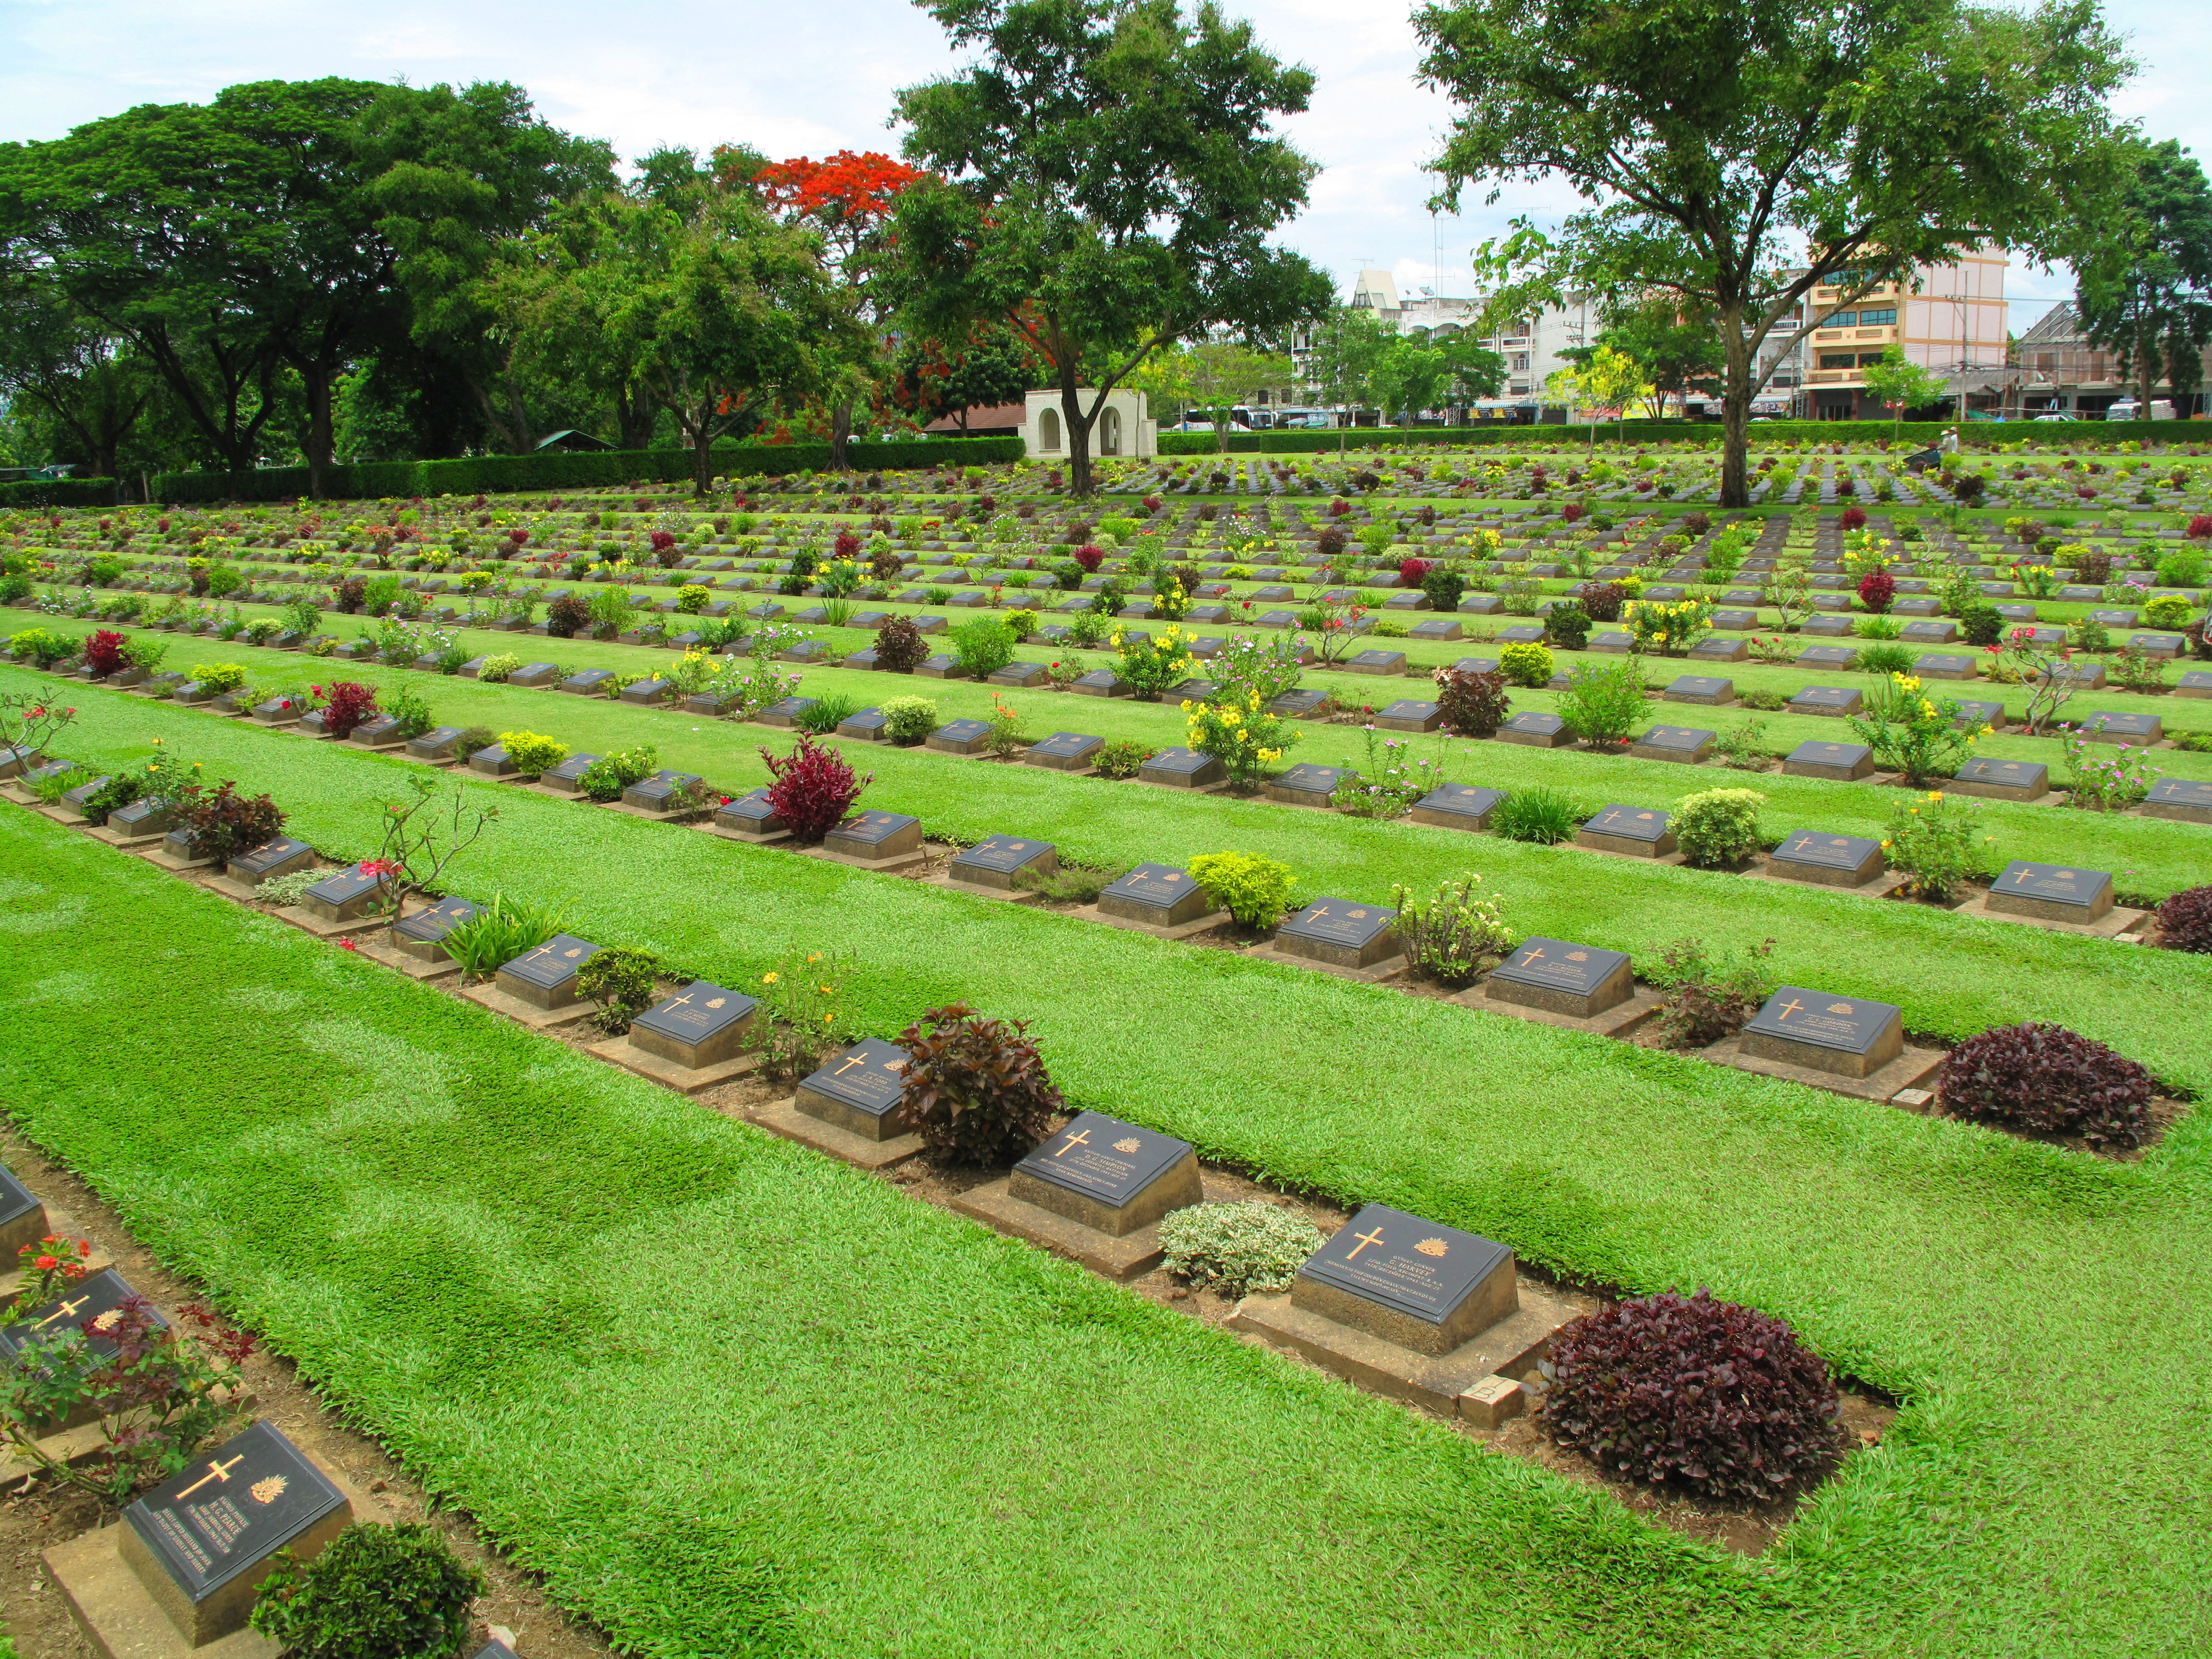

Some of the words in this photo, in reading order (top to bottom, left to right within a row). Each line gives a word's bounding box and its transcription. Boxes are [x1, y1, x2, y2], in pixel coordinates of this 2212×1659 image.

[1098, 1159, 1127, 1171] SIMPSON
[1398, 1263, 1432, 1277] HARVEY
[1398, 1269, 1425, 1280] REGIMENT
[1469, 1387, 1495, 1399] B
[208, 1501, 220, 1511] H.
[213, 1507, 226, 1517] G.
[192, 1512, 212, 1532] NOVEMBER
[219, 1513, 243, 1536] PEARCE
[232, 1511, 249, 1528] PRIVATE
[161, 1508, 176, 1523] DEARLY
[172, 1521, 186, 1535] LOVED
[182, 1532, 200, 1550] HUSBAND
[207, 1515, 224, 1532] MEDICAL
[220, 1530, 234, 1543] CORPS
[172, 1535, 188, 1552] LINDSAY
